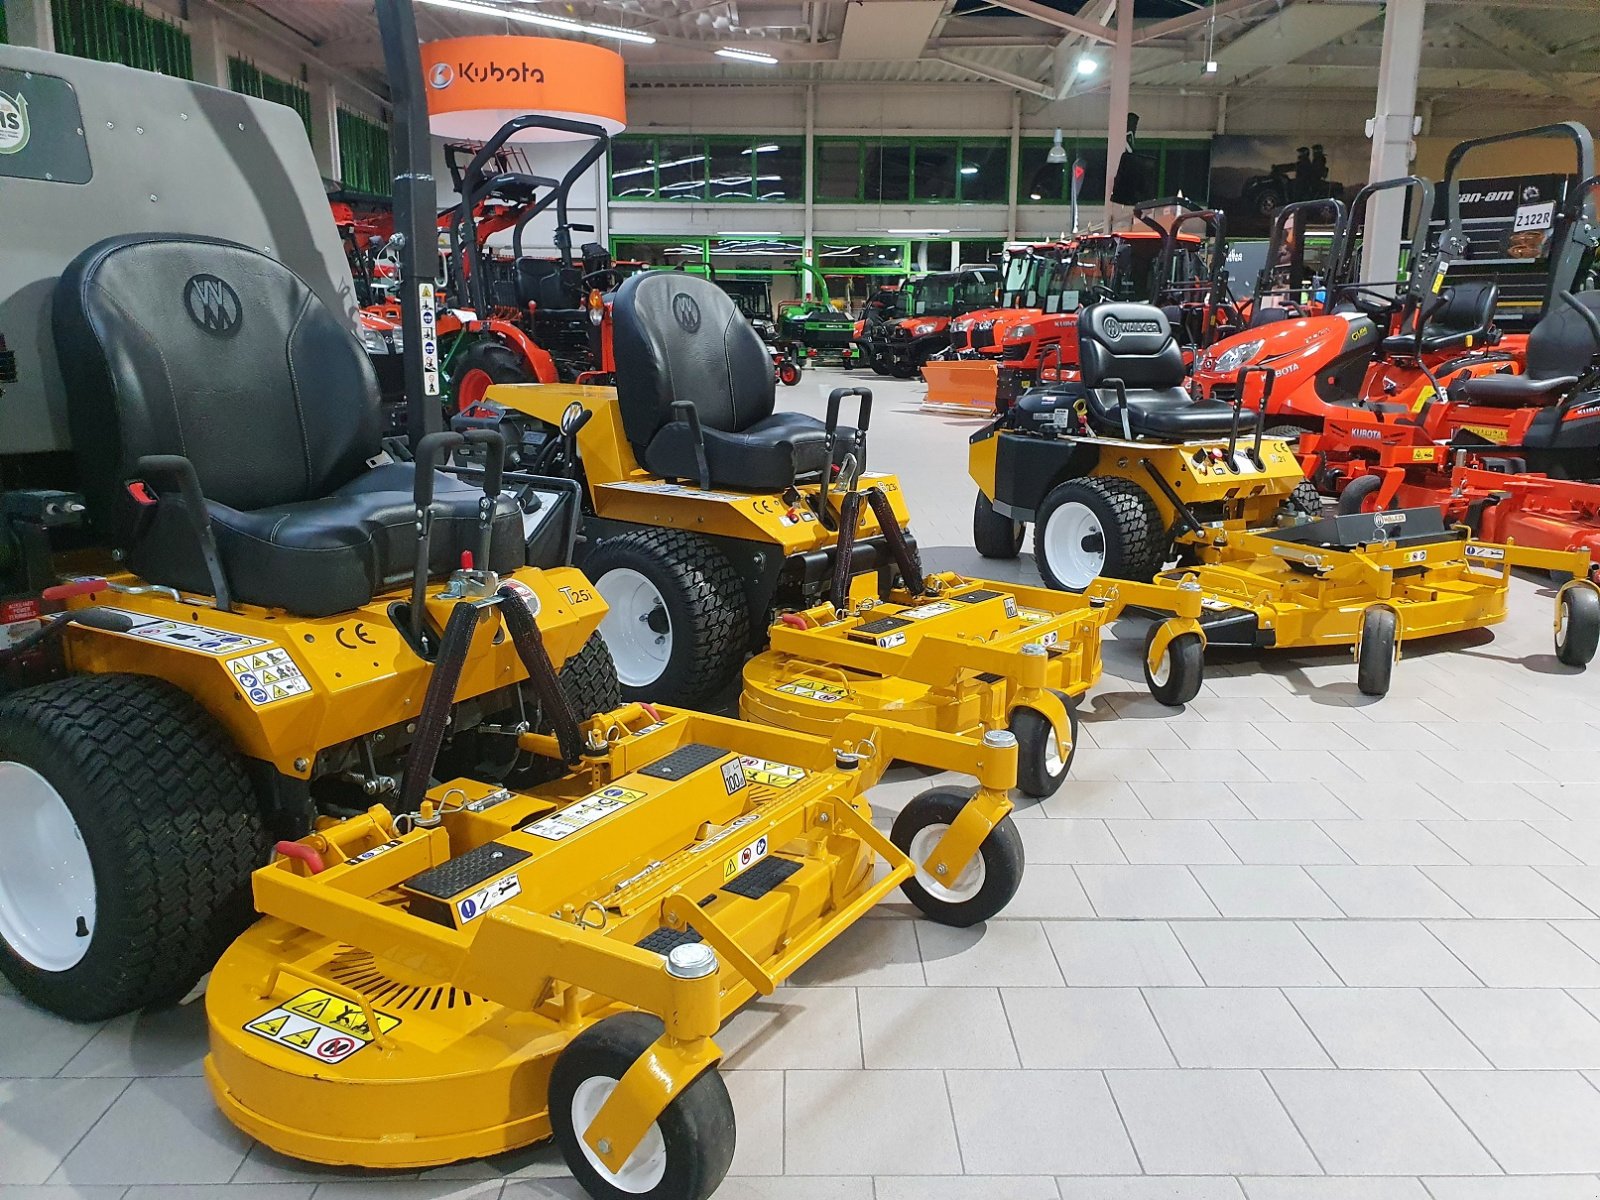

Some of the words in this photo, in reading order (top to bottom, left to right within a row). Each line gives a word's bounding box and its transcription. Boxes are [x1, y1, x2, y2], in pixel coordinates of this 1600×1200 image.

[458, 61, 545, 84] Kubota
[1120, 321, 1160, 334] WALKER
[1260, 362, 1300, 383] KBOTA
[1576, 405, 1600, 415] KUBO
[1351, 427, 1382, 440] KUBOTA
[557, 585, 593, 606] T25i
[335, 622, 376, 650] CE
[726, 773, 741, 792] 100
